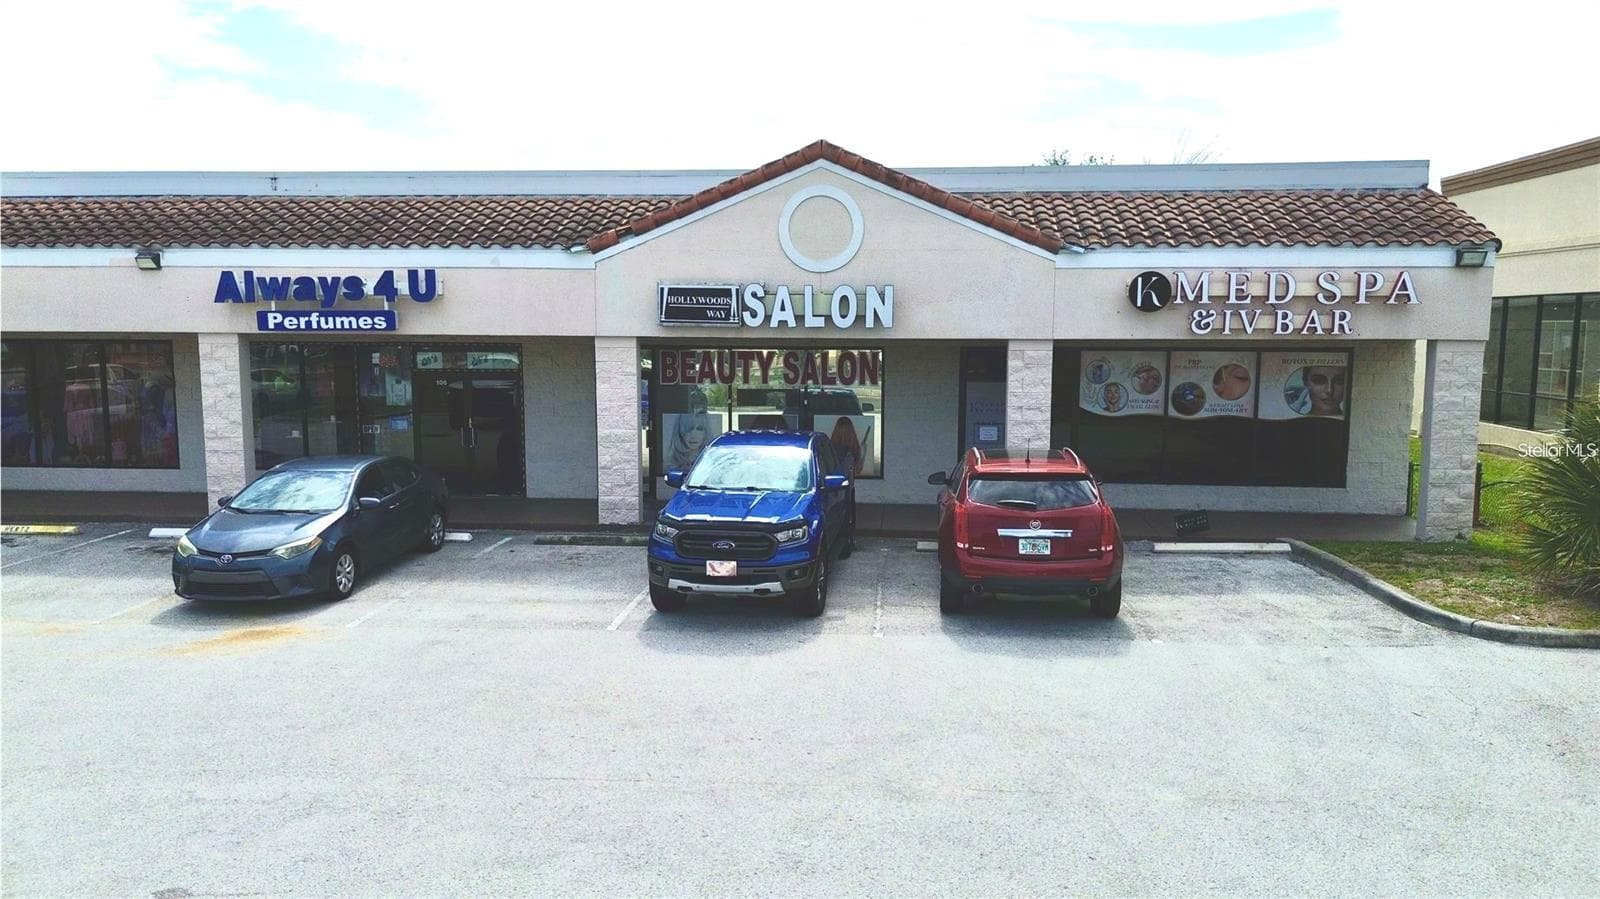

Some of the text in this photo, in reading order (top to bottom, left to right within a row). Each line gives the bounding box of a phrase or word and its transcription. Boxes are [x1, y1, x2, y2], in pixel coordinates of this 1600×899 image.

[214, 269, 437, 308] Always 4 U
[667, 295, 732, 304] HOLLYWOODS
[1136, 271, 1422, 307] K MED SPA
[706, 310, 727, 318] WAY
[742, 284, 894, 328] SALON
[267, 313, 387, 330] Perfumes
[1190, 309, 1354, 335] & IV BAR
[660, 350, 881, 385] BEAUTY SALON
